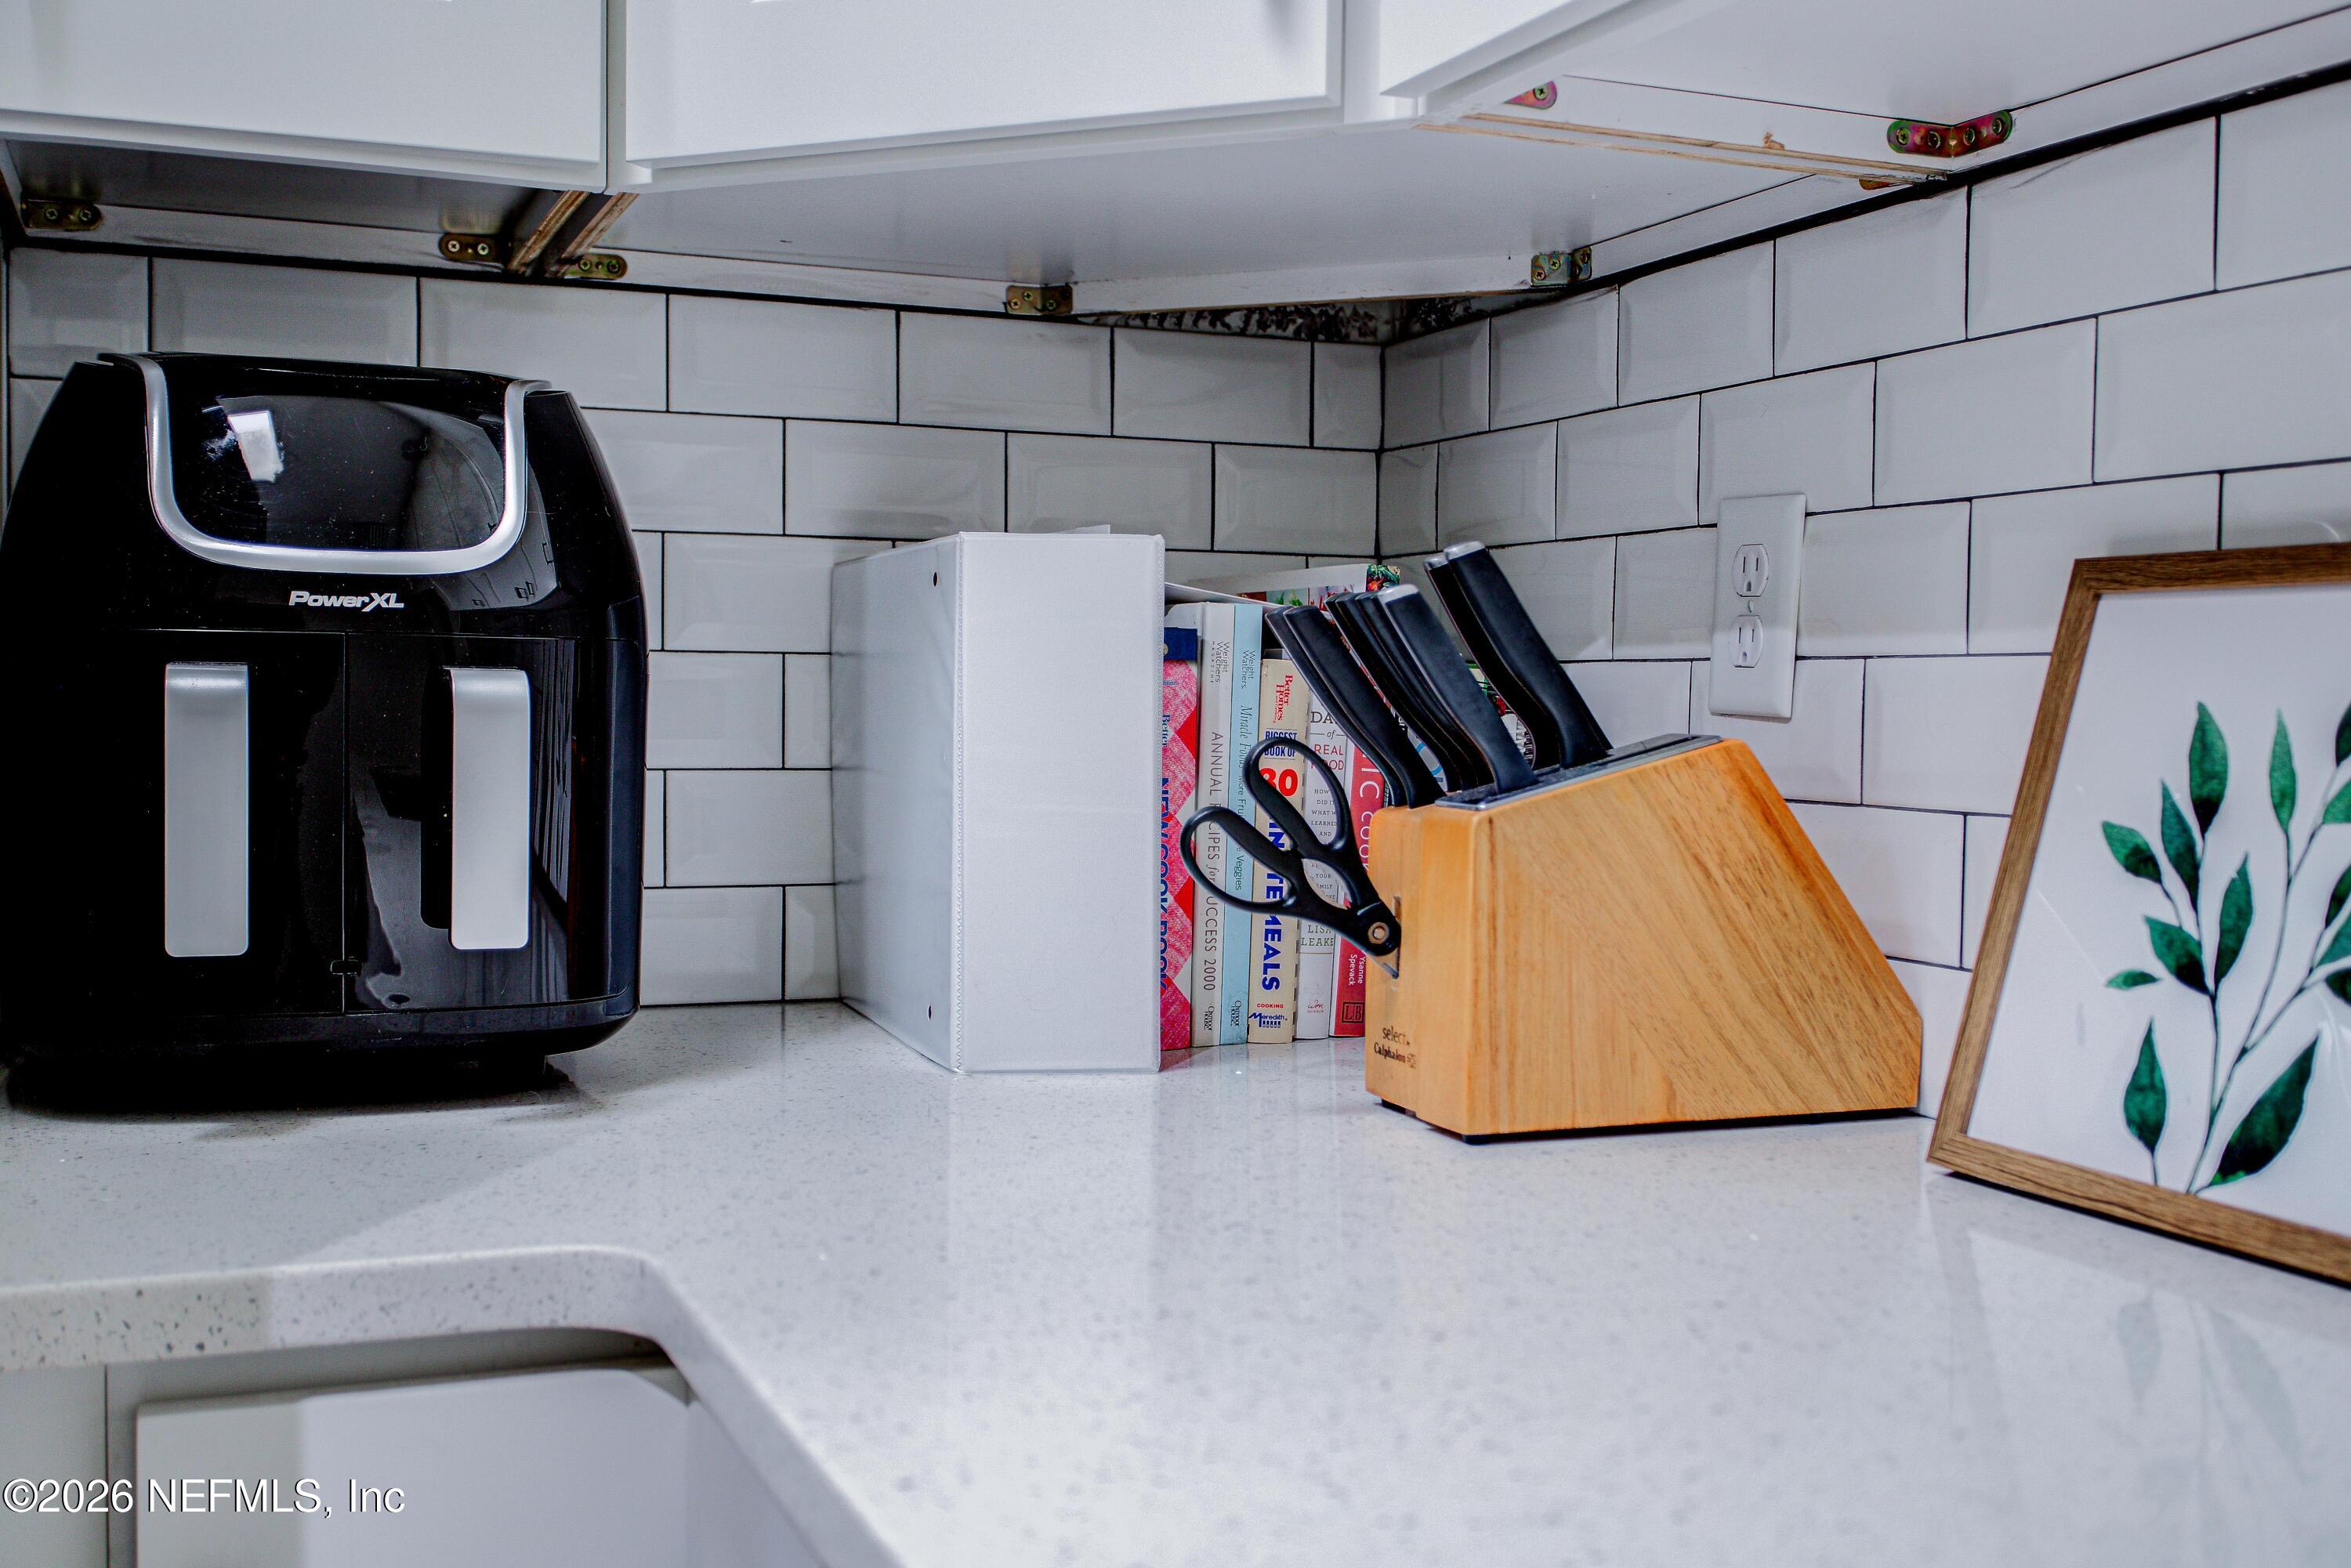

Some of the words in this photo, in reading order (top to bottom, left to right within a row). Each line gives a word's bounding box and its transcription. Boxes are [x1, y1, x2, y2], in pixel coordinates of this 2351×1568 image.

[288, 591, 404, 612] PowerXL
[1215, 641, 1223, 683] Watchers
[1221, 642, 1230, 673] Weight
[1247, 650, 1255, 679] Weight
[1276, 684, 1284, 721] Homes
[1284, 675, 1294, 706] Better
[1239, 705, 1252, 739] Miracle
[1327, 730, 1336, 740] of
[1209, 732, 1224, 796] ANNUAL
[1313, 744, 1344, 756] REAL
[1206, 864, 1219, 882] for
[1233, 855, 1244, 891] Veggies
[1204, 896, 1219, 952] UCCESS
[1203, 959, 1216, 990] 2000
[1348, 954, 1358, 986] Spevack
[1357, 956, 1366, 984] Ysanne
